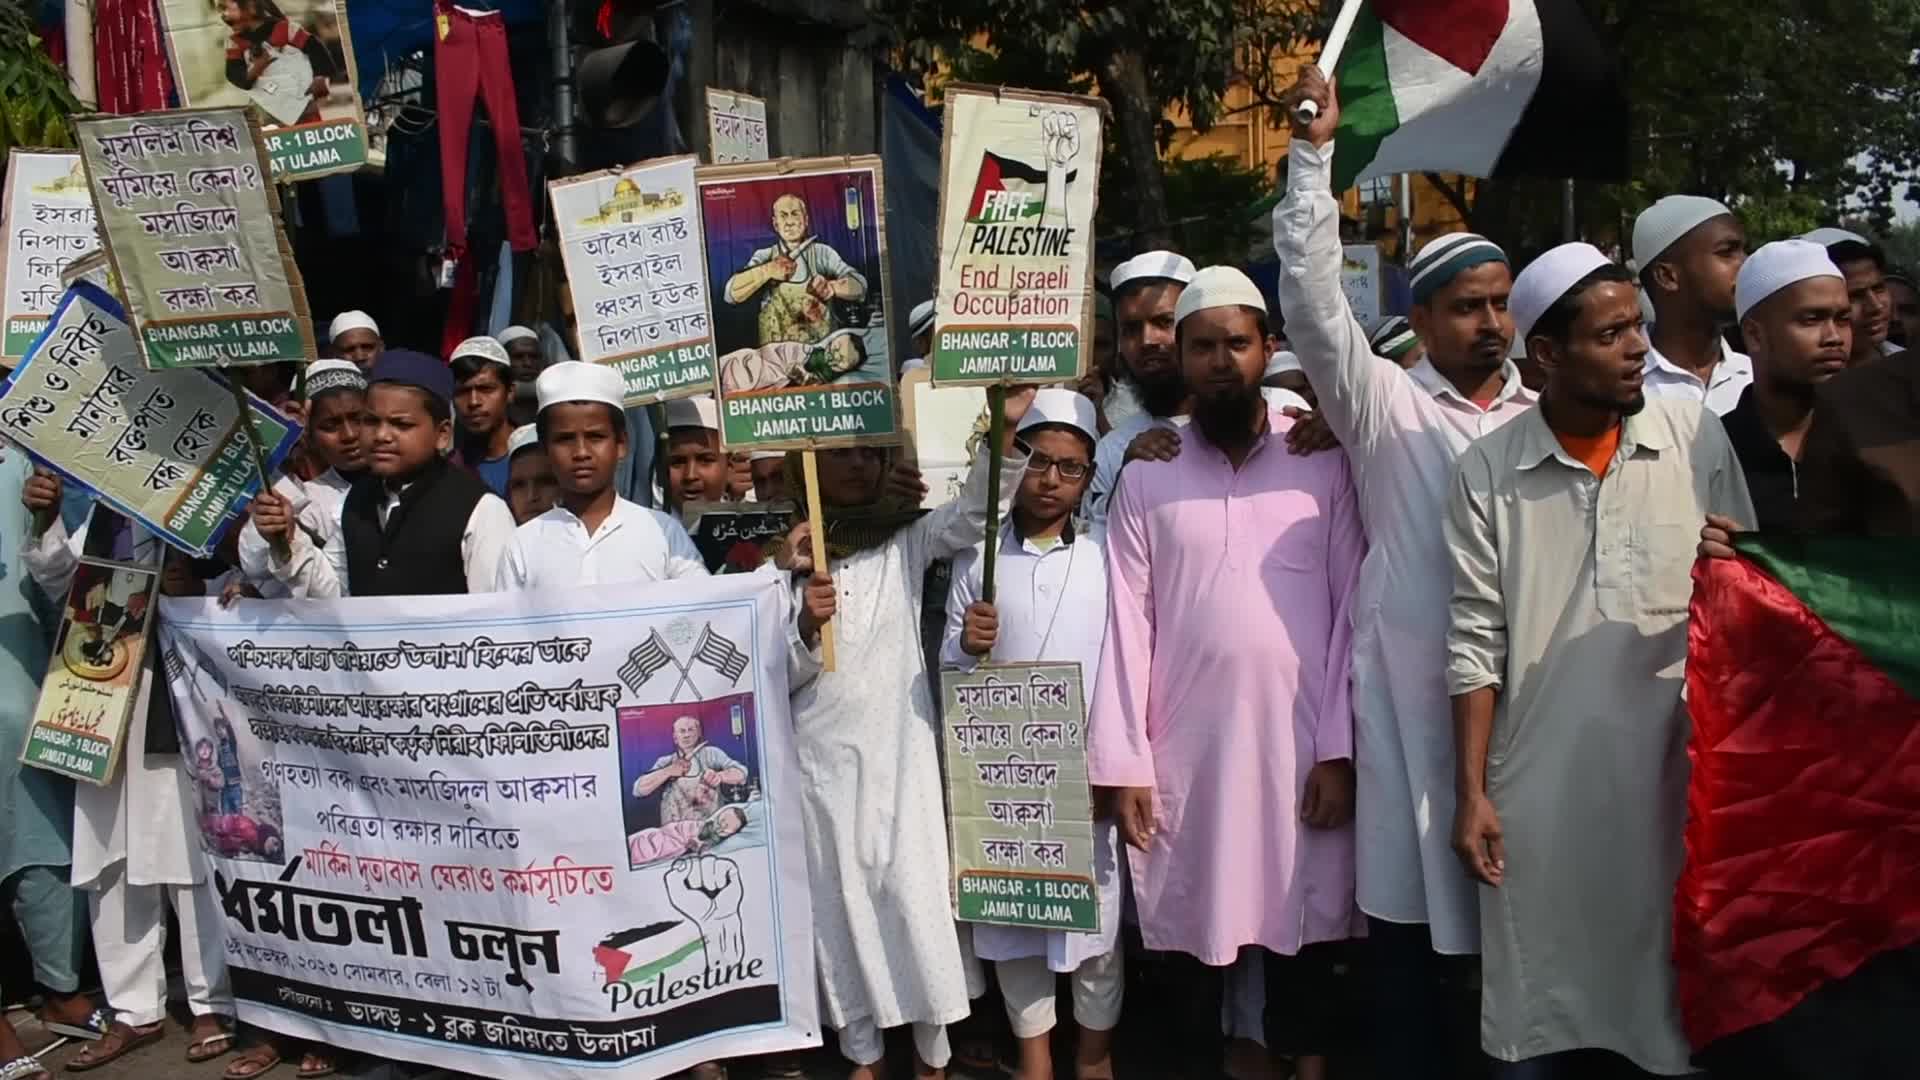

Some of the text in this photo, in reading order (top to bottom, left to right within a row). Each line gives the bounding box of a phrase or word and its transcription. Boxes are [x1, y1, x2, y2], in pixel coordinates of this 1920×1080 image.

[98, 119, 240, 167] মুসলিম বিশ্ব
[294, 132, 302, 147] 1
[304, 123, 357, 146] BLOCK
[289, 147, 341, 169] ULAMA
[100, 167, 178, 207] ঘুমিয়ে
[188, 169, 236, 194] কেন
[32, 203, 97, 224] ইসরা
[137, 202, 238, 237] মসজিদে
[978, 191, 1032, 221] FREE
[18, 229, 88, 250] নিপাত
[582, 229, 643, 256] অবৈধ
[969, 225, 1076, 257] PALESTINE
[160, 247, 240, 272] আক্বসা
[596, 253, 683, 288] ইসরাইল
[960, 264, 1069, 290] End Israeli
[161, 284, 259, 312] রক্ষা কর
[595, 281, 700, 318] ধ্বংস হউক
[953, 291, 1069, 321] Occupation
[11, 320, 50, 334] BHAN
[148, 323, 219, 343] BHANGAR
[231, 325, 240, 337] 1
[243, 318, 293, 336] BLOCK
[598, 312, 707, 352] নিপাত যাক
[941, 333, 1009, 350] BHANGAR
[1021, 333, 1029, 349] 1
[1031, 332, 1074, 349] BLOCK
[175, 341, 280, 362] JAMIAT ULAMA
[668, 350, 675, 364] 1
[959, 356, 1056, 374] JAMIAT ULAMA
[2, 312, 117, 437] শিশু ও নিরীহ
[623, 364, 710, 394] AMIAT ULAMA
[67, 365, 136, 438] মানুষের
[728, 395, 807, 417] BHANGAR
[818, 393, 828, 410] 1
[833, 389, 884, 409] BLOCK
[107, 387, 175, 465] রক্তপাত
[753, 415, 865, 438] JAMIAT ULAMA
[144, 408, 217, 491] বন্ধ হোক
[169, 472, 219, 531] BHANGAR
[218, 455, 230, 467] 1
[200, 485, 236, 528] JAMIAT
[399, 640, 468, 669] উলামা
[537, 637, 592, 663] ডাকে
[424, 690, 503, 718] সংগ্রামের
[505, 681, 545, 715] প্রতি
[956, 674, 1069, 715] মুসলিম বিশ্ব
[33, 726, 72, 747] BHANGAR
[81, 738, 109, 758] BLOCK
[953, 716, 1011, 751] ঘুমিয়ে
[1021, 722, 1065, 747] কেন
[66, 752, 94, 773] ULAMA
[978, 754, 1057, 786] মসজিদে
[261, 760, 322, 789] গণহত্যা
[359, 775, 394, 798] এবং
[394, 770, 489, 810] মাসজিদুল
[496, 772, 597, 803] আক্বসার
[316, 804, 520, 850] পবিত্রতা রক্ষার দাবিতে
[988, 801, 1053, 826] আক্বসা
[982, 839, 1065, 866] রক্ষা কর
[303, 840, 352, 880] মার্কিন
[431, 864, 495, 893] ঘেরাও
[498, 855, 614, 906] কর্মসূচিতে
[962, 877, 1024, 895] BHANGAR
[1034, 882, 1041, 896] 1
[1044, 882, 1090, 899] BLOCK
[214, 856, 560, 994] ধর্মতলা চলুন
[980, 900, 1073, 922] JAMIAT ULAMA
[298, 954, 339, 977] ২০২৩
[415, 970, 451, 994] বেলা
[602, 958, 763, 1013] Palestine
[442, 1015, 477, 1042] ব্লক
[481, 1016, 570, 1052] জমিয়তে
[570, 1025, 656, 1056] উলামা
